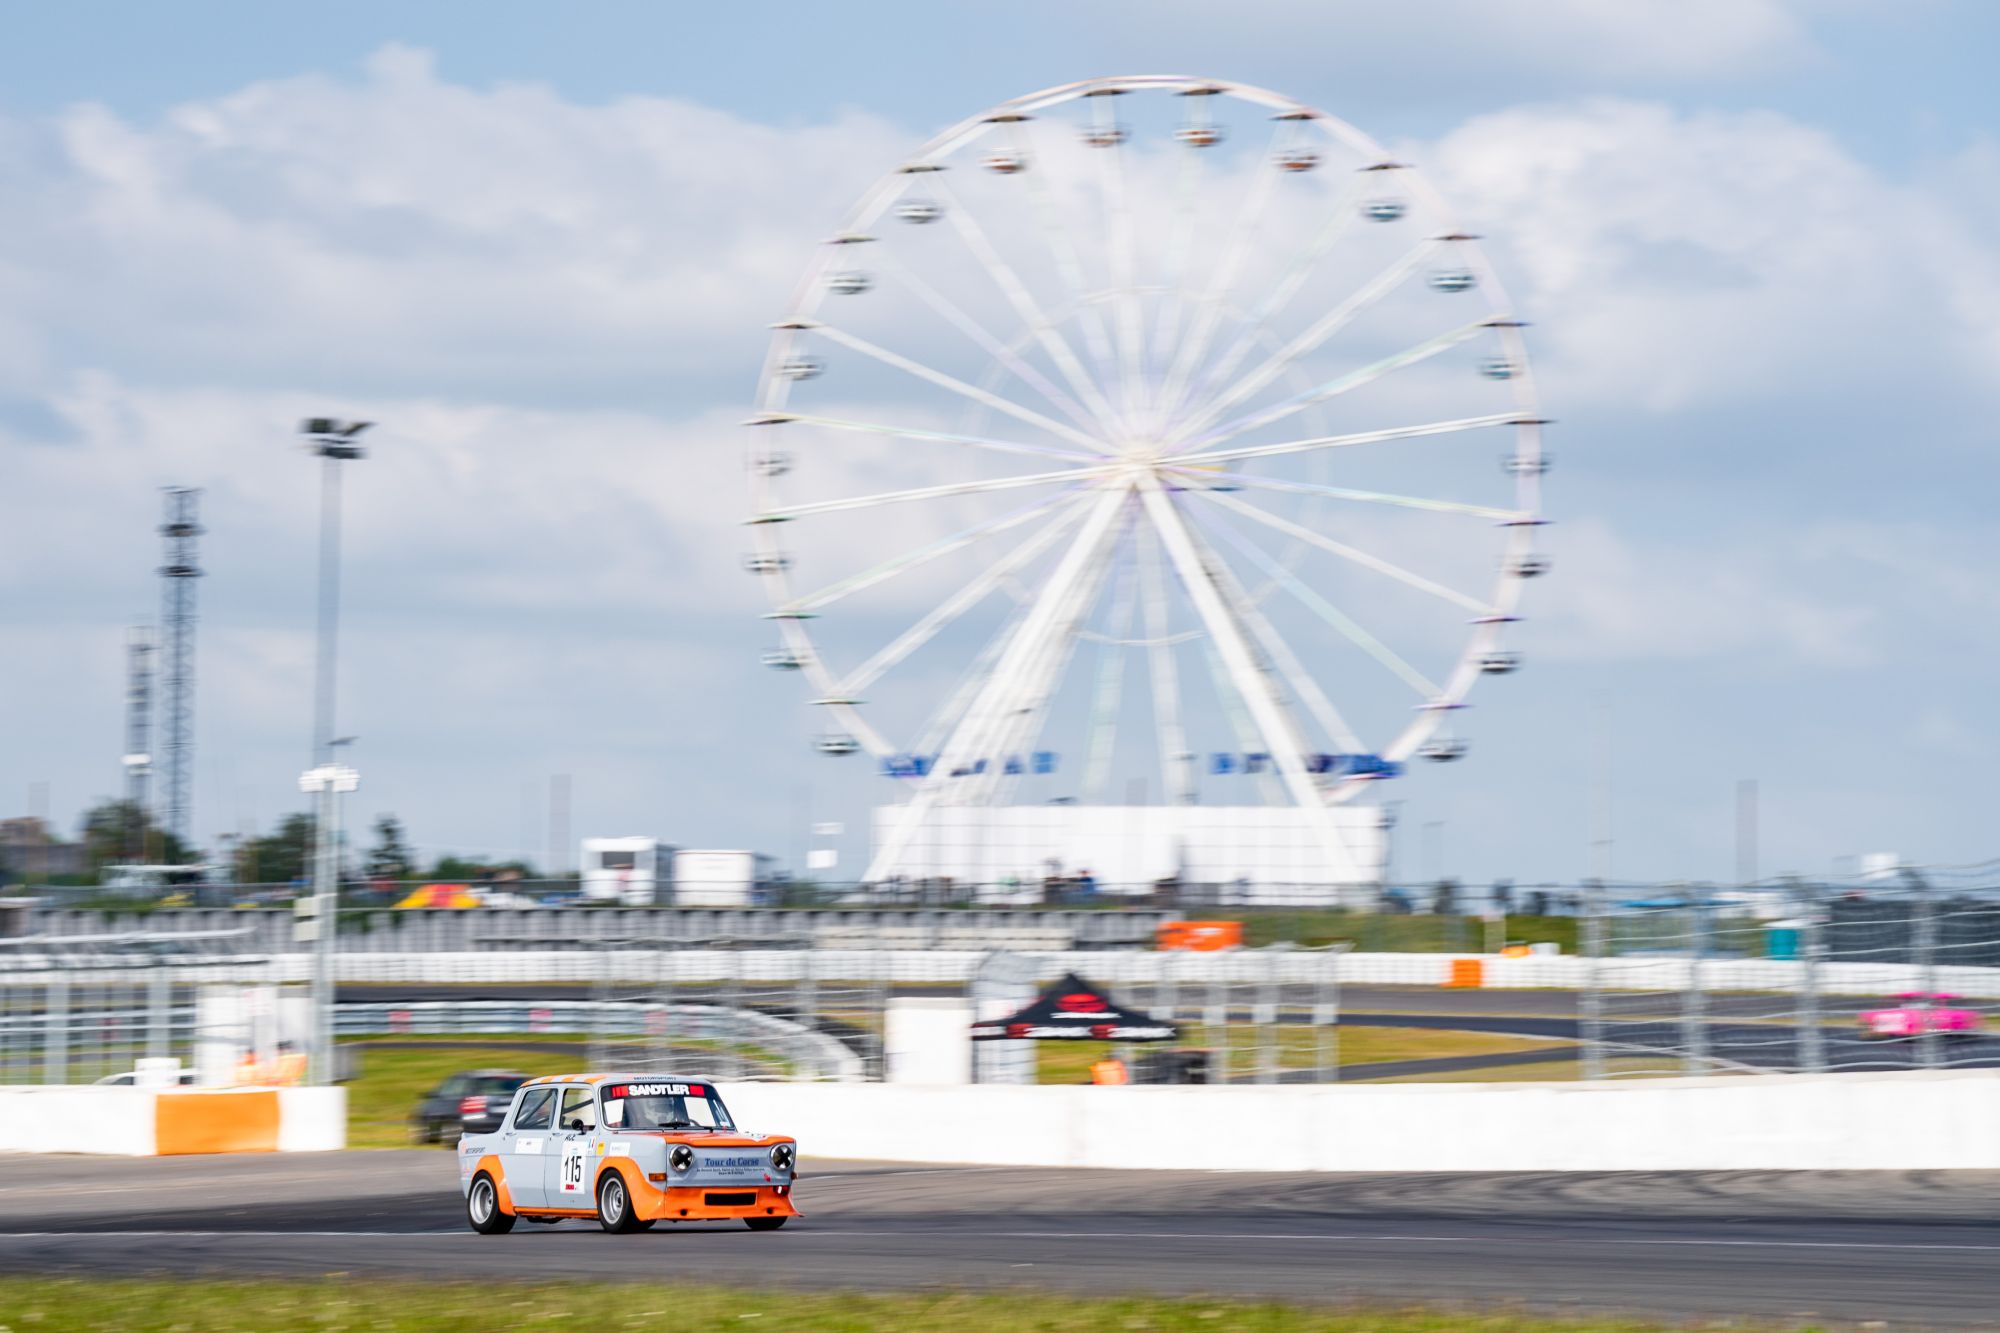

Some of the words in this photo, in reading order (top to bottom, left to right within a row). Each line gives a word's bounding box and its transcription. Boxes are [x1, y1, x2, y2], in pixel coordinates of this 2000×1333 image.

[628, 1084, 690, 1096] SANDTLER
[705, 1158, 724, 1167] Tour
[564, 1155, 582, 1183] 115
